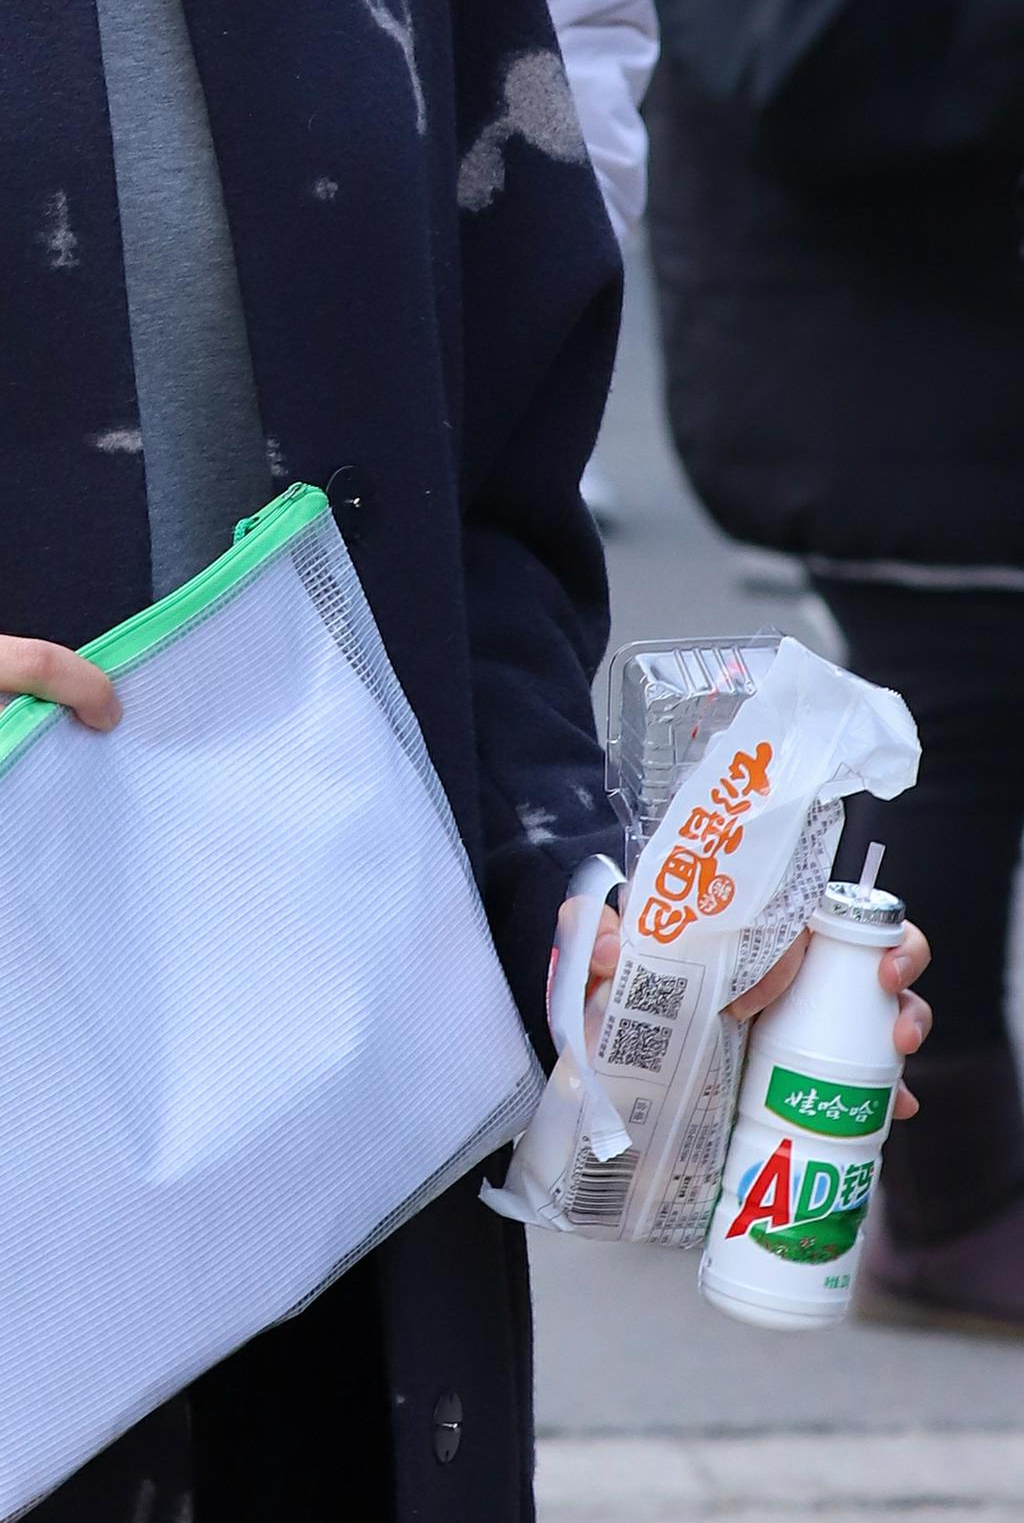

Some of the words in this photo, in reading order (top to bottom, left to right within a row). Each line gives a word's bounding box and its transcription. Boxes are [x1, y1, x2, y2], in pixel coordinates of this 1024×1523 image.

[638, 741, 773, 944] 奶香面包
[784, 1087, 874, 1122] 娃哈哈
